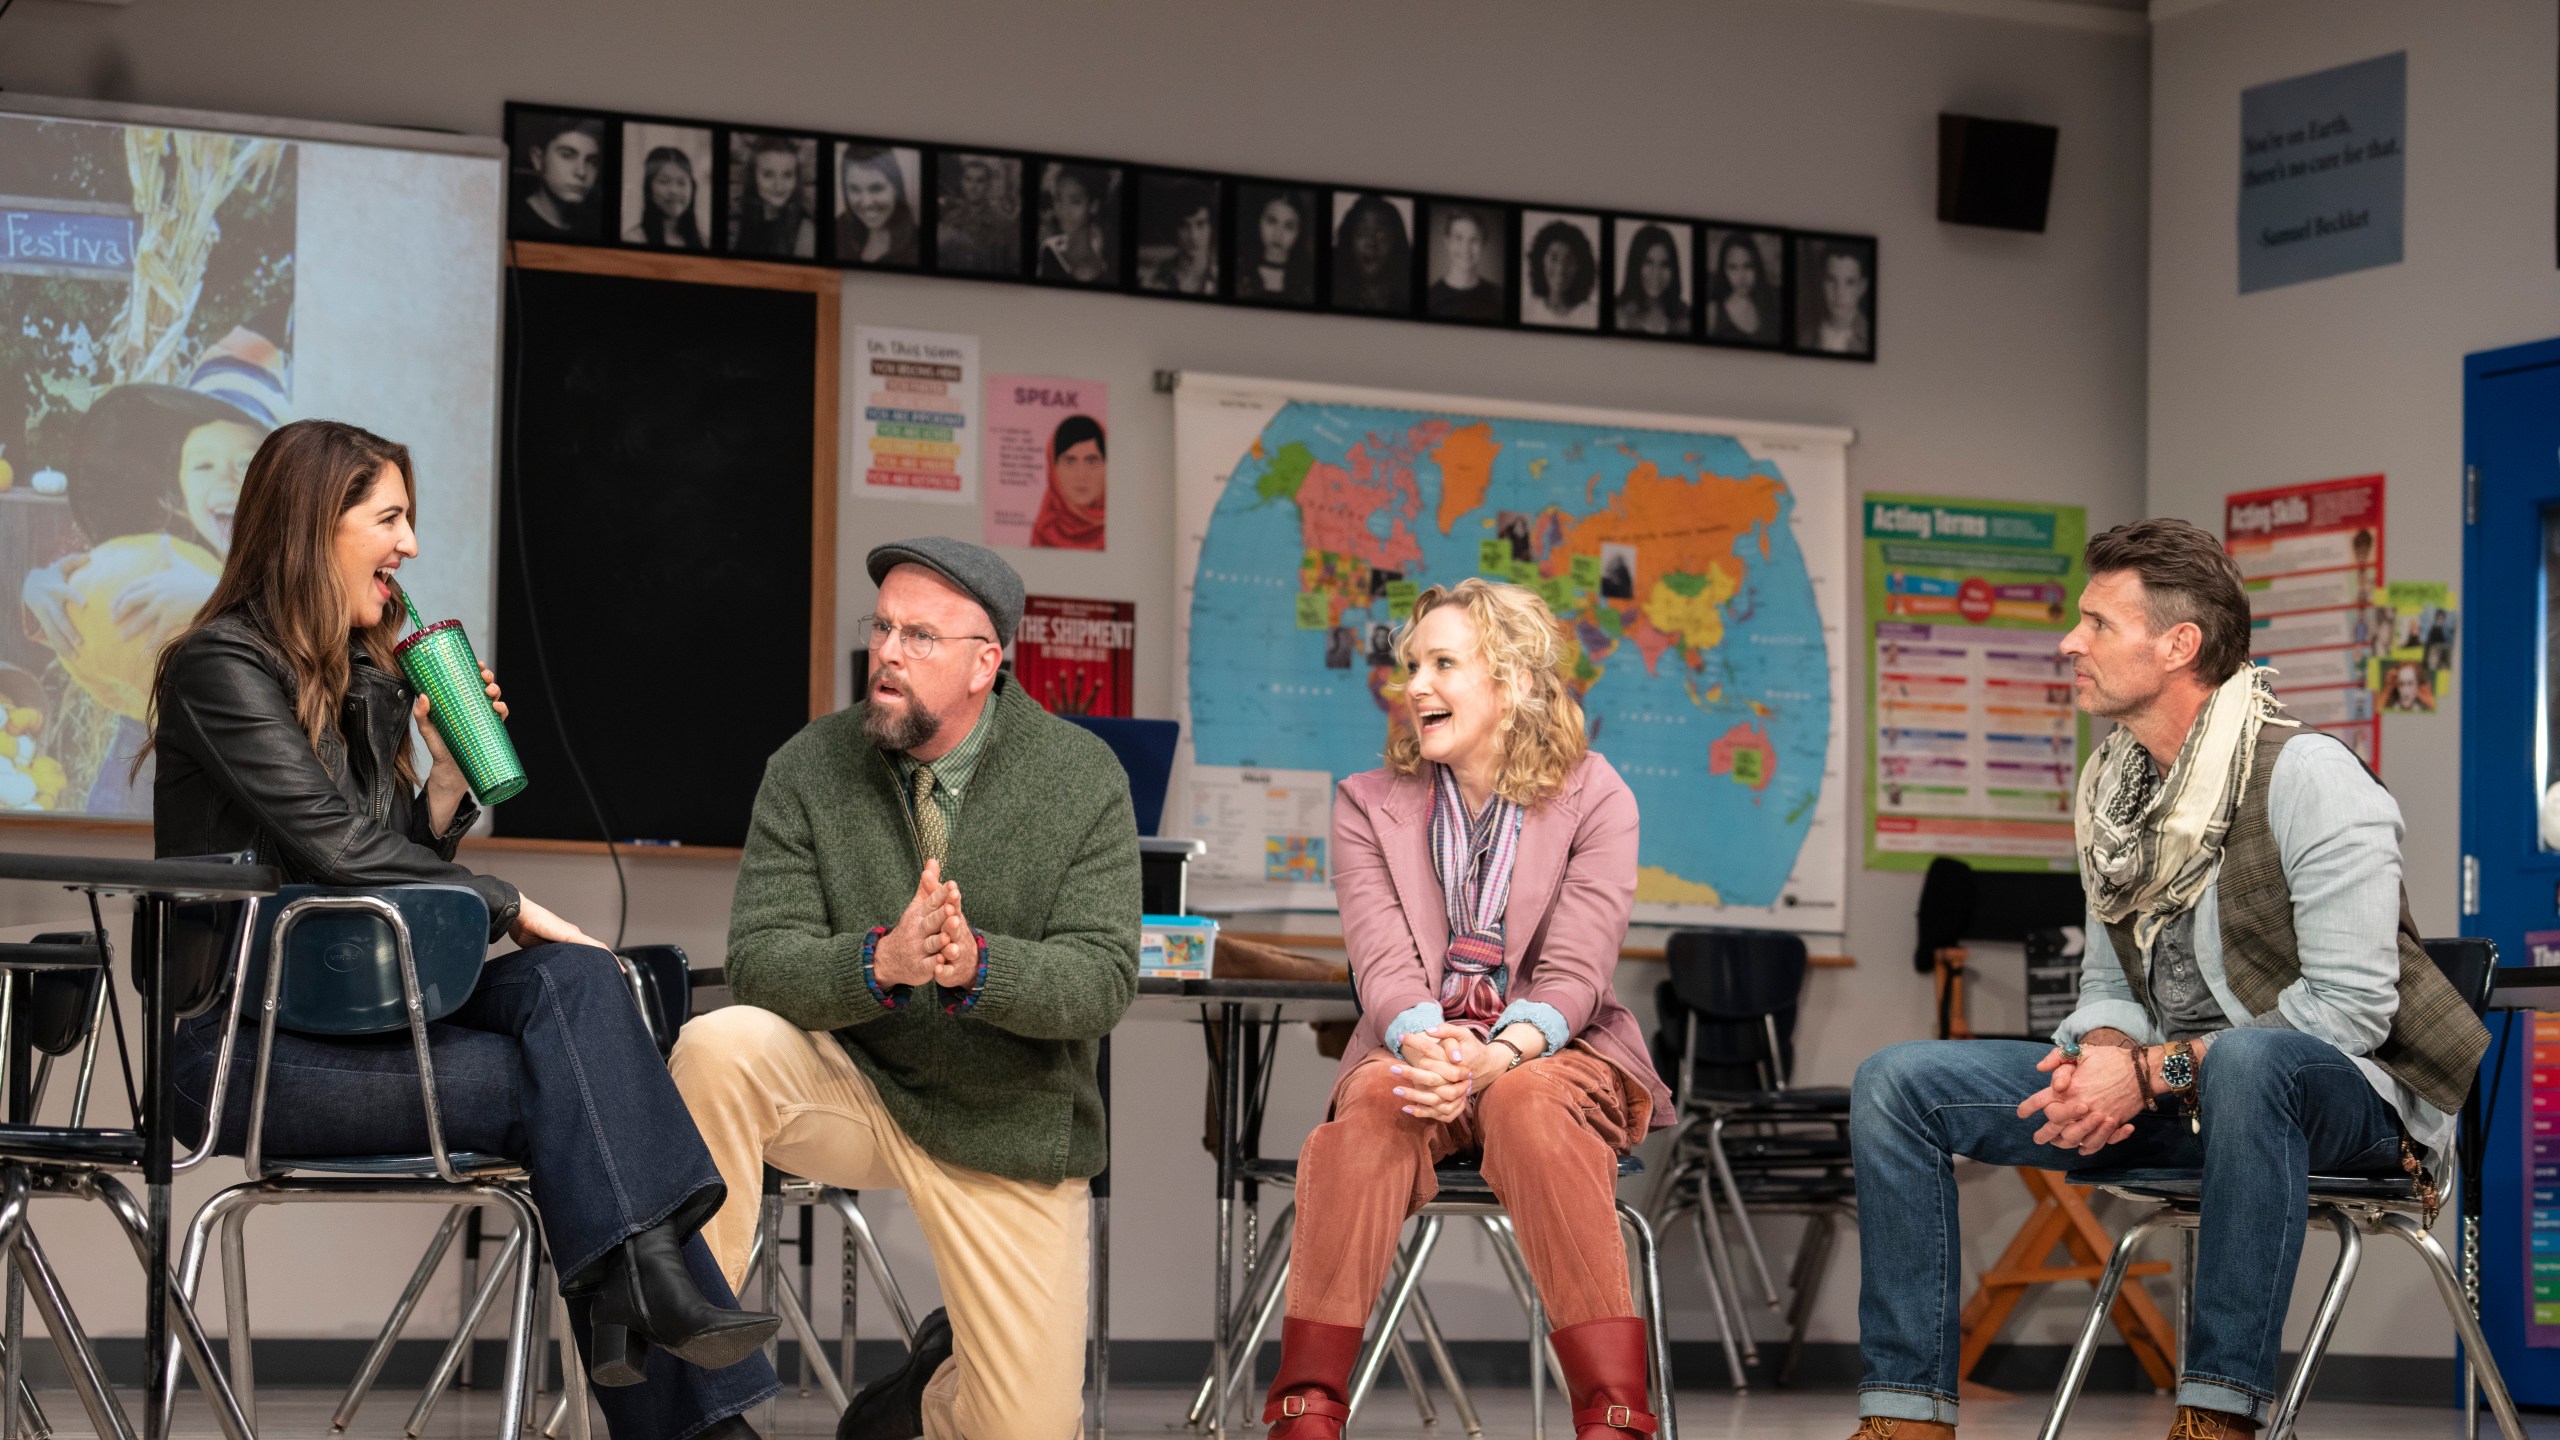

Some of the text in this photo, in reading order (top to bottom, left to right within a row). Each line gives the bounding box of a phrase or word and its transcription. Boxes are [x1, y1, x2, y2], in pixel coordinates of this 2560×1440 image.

[2286, 130, 2305, 146] on
[2288, 161, 2307, 177] no
[2309, 153, 2340, 174] cure
[2343, 142, 2364, 166] for
[7, 213, 137, 266] Festival
[867, 339, 886, 354] In
[891, 340, 920, 357] this
[1014, 387, 1079, 408] SPEAK
[1873, 504, 1932, 539] Acting
[1933, 508, 1987, 537] Terms
[2231, 503, 2271, 533] Acting
[2271, 495, 2308, 525] Skills
[1018, 615, 1133, 649] THE SHIPMENT
